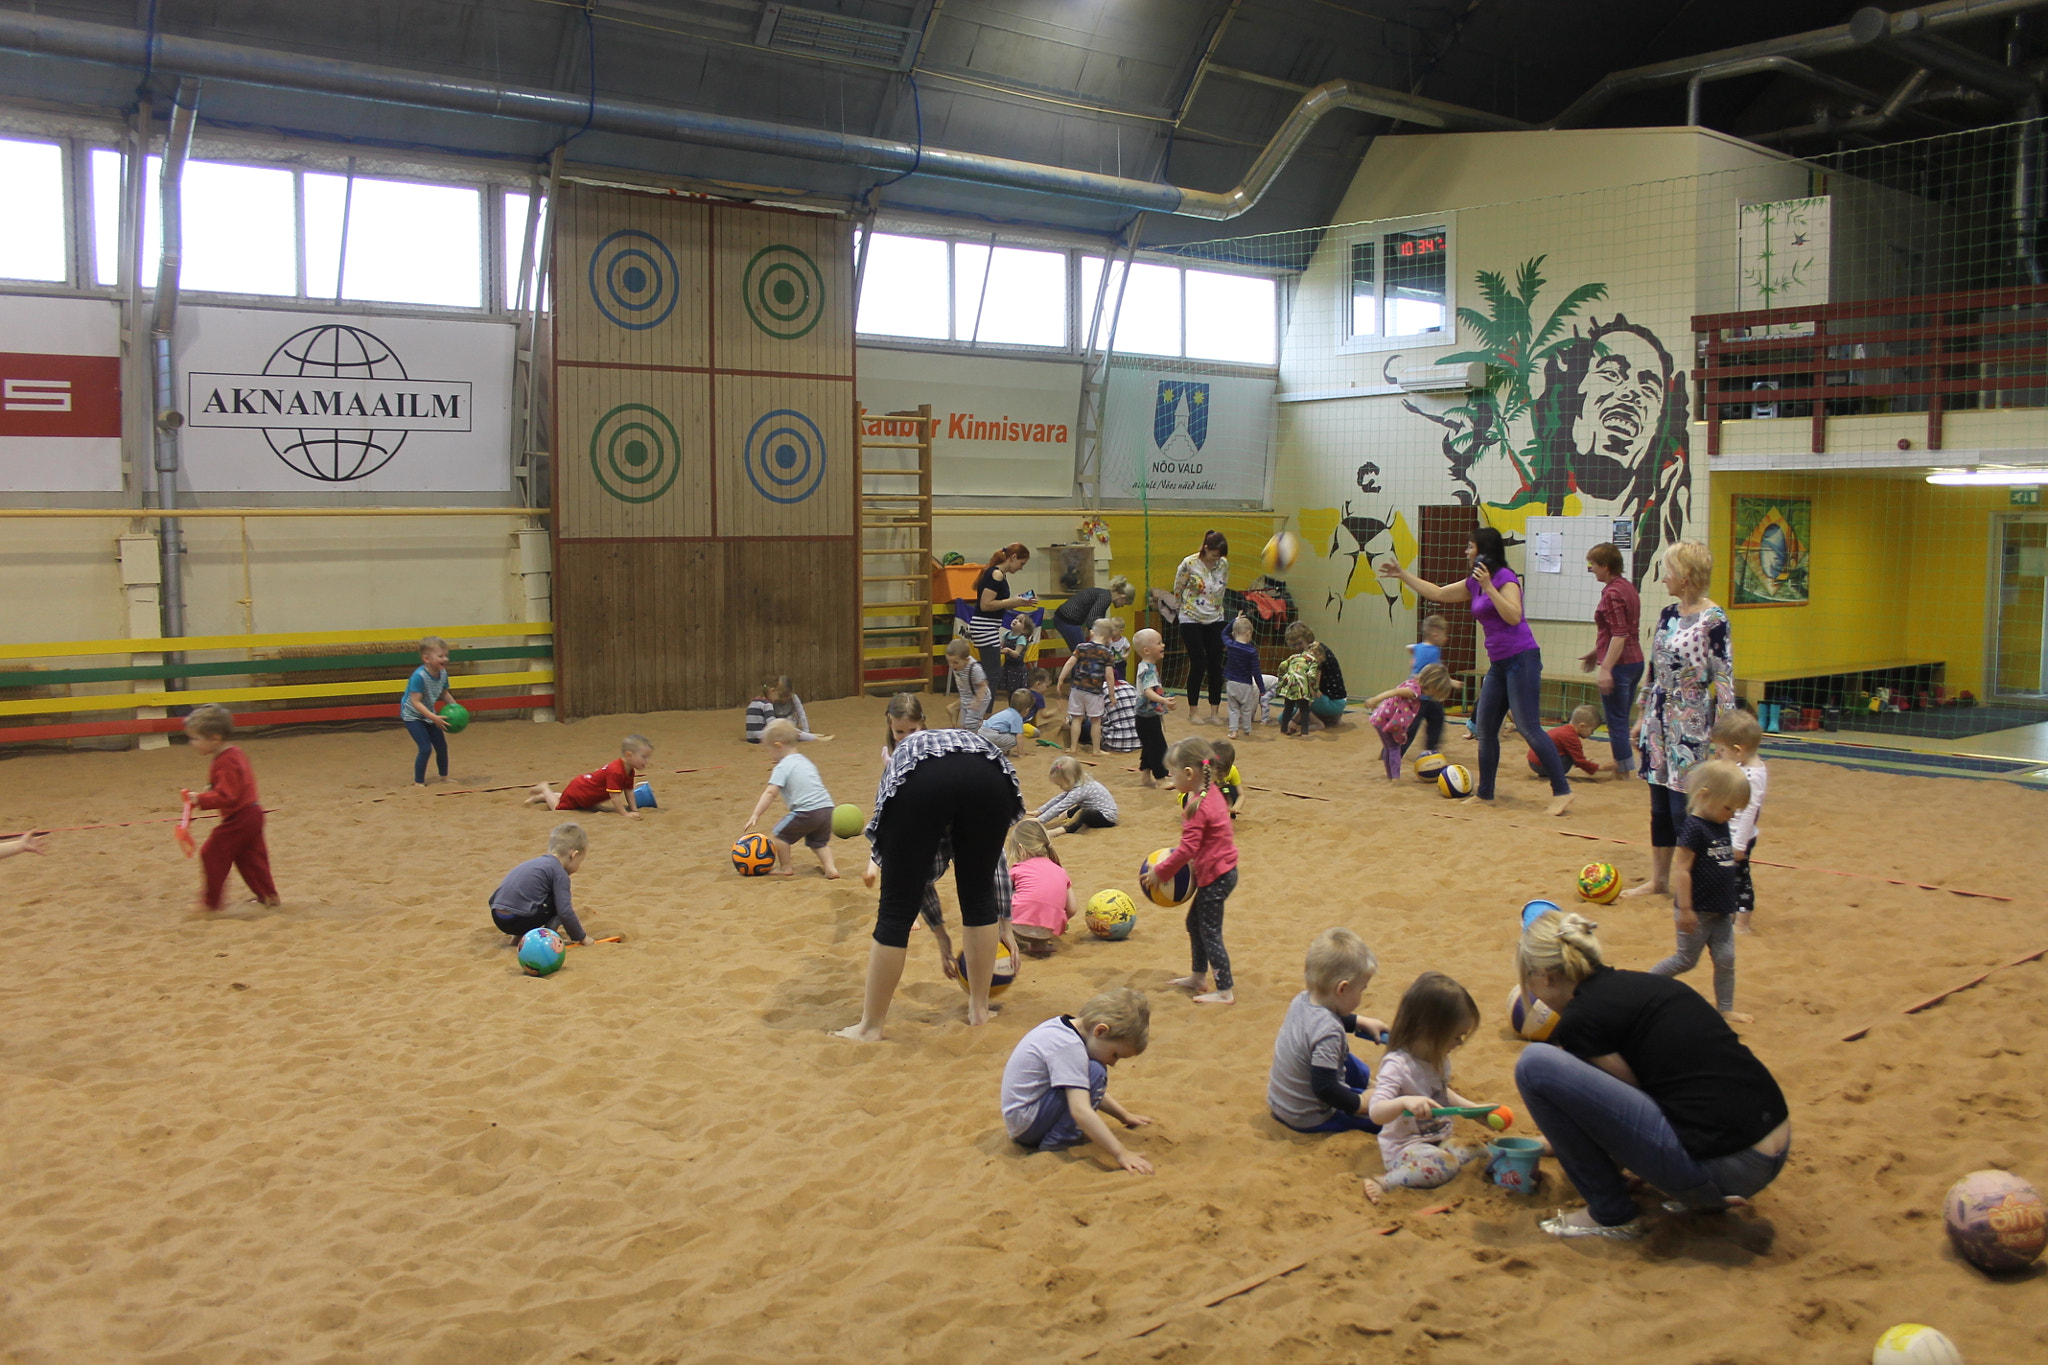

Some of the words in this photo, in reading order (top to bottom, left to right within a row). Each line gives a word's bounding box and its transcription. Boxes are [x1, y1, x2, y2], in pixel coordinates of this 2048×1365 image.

[202, 387, 461, 418] AKNAMAAILM
[948, 412, 1068, 443] Kinnisvara
[1152, 460, 1176, 474] NÕO
[1178, 463, 1203, 474] VALD
